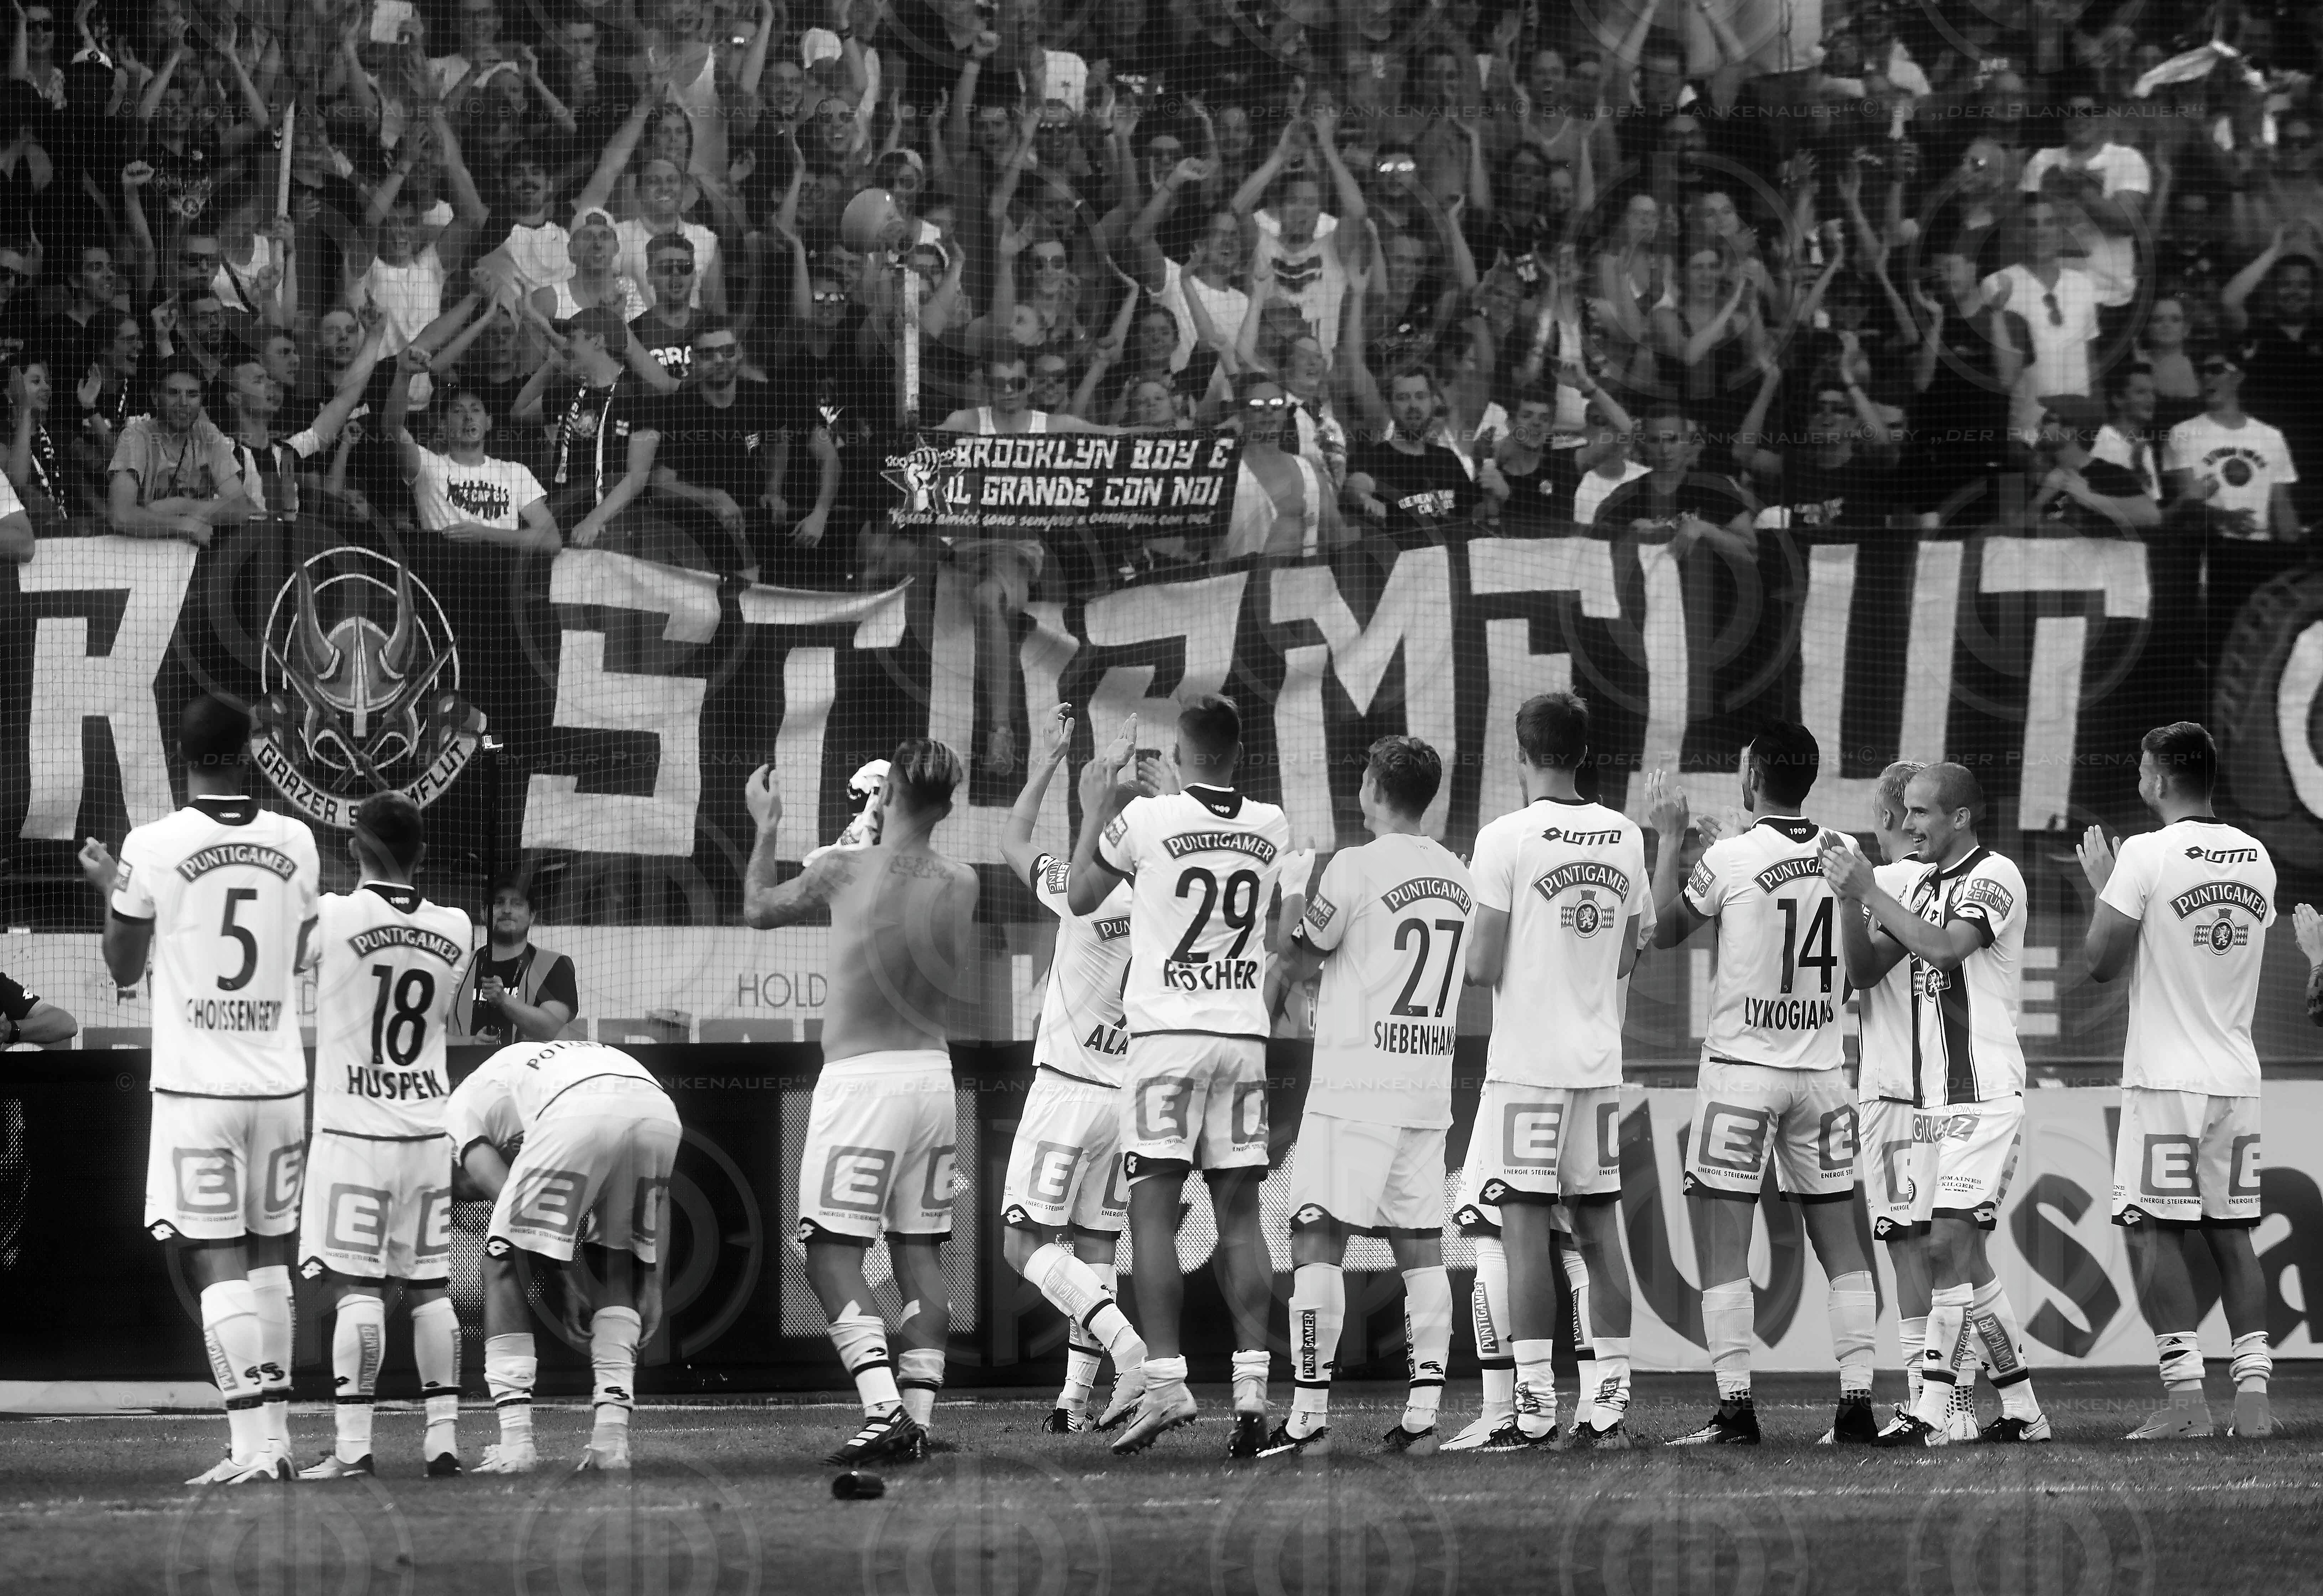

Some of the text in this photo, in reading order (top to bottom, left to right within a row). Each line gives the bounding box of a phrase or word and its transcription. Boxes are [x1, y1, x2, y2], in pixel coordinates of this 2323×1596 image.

[953, 437, 1119, 469] BROOKLYN
[1130, 439, 1199, 470] BOY
[945, 476, 1223, 507] IL GRANDE CON NOI
[257, 744, 338, 823] GRAZER
[180, 845, 294, 879] PUNTIGAMER
[1168, 833, 1275, 861] PUNTIGAMER
[1540, 865, 1630, 901] PUNTIGAMER
[1760, 859, 1824, 889] PUNTIGA
[1388, 879, 1471, 913] PUNTIGAMER
[1967, 890, 2007, 916] ZEITUNG
[1972, 880, 2012, 906] KLEINE
[2176, 885, 2267, 919] PUNTIGAMER
[1171, 866, 1260, 963] 29
[217, 887, 258, 991] 5
[356, 929, 461, 962] PUNTIGAMER
[1777, 897, 1838, 994] 14
[1163, 959, 1258, 991] RÖCHER
[1390, 918, 1464, 1018] 27
[372, 963, 435, 1066] 18
[1943, 1104, 1983, 1115] HOLDING
[1697, 1166, 1759, 1181] ENERGIE STEIERMARK
[1821, 1170, 1845, 1179] ENERGIE
[1026, 1199, 1043, 1209] ENERGIE
[1474, 1282, 1496, 1351] PUNTIGAMER
[1953, 1310, 1973, 1368] PUNTIGAMER
[1979, 1316, 2014, 1370] PUNTIGAMER
